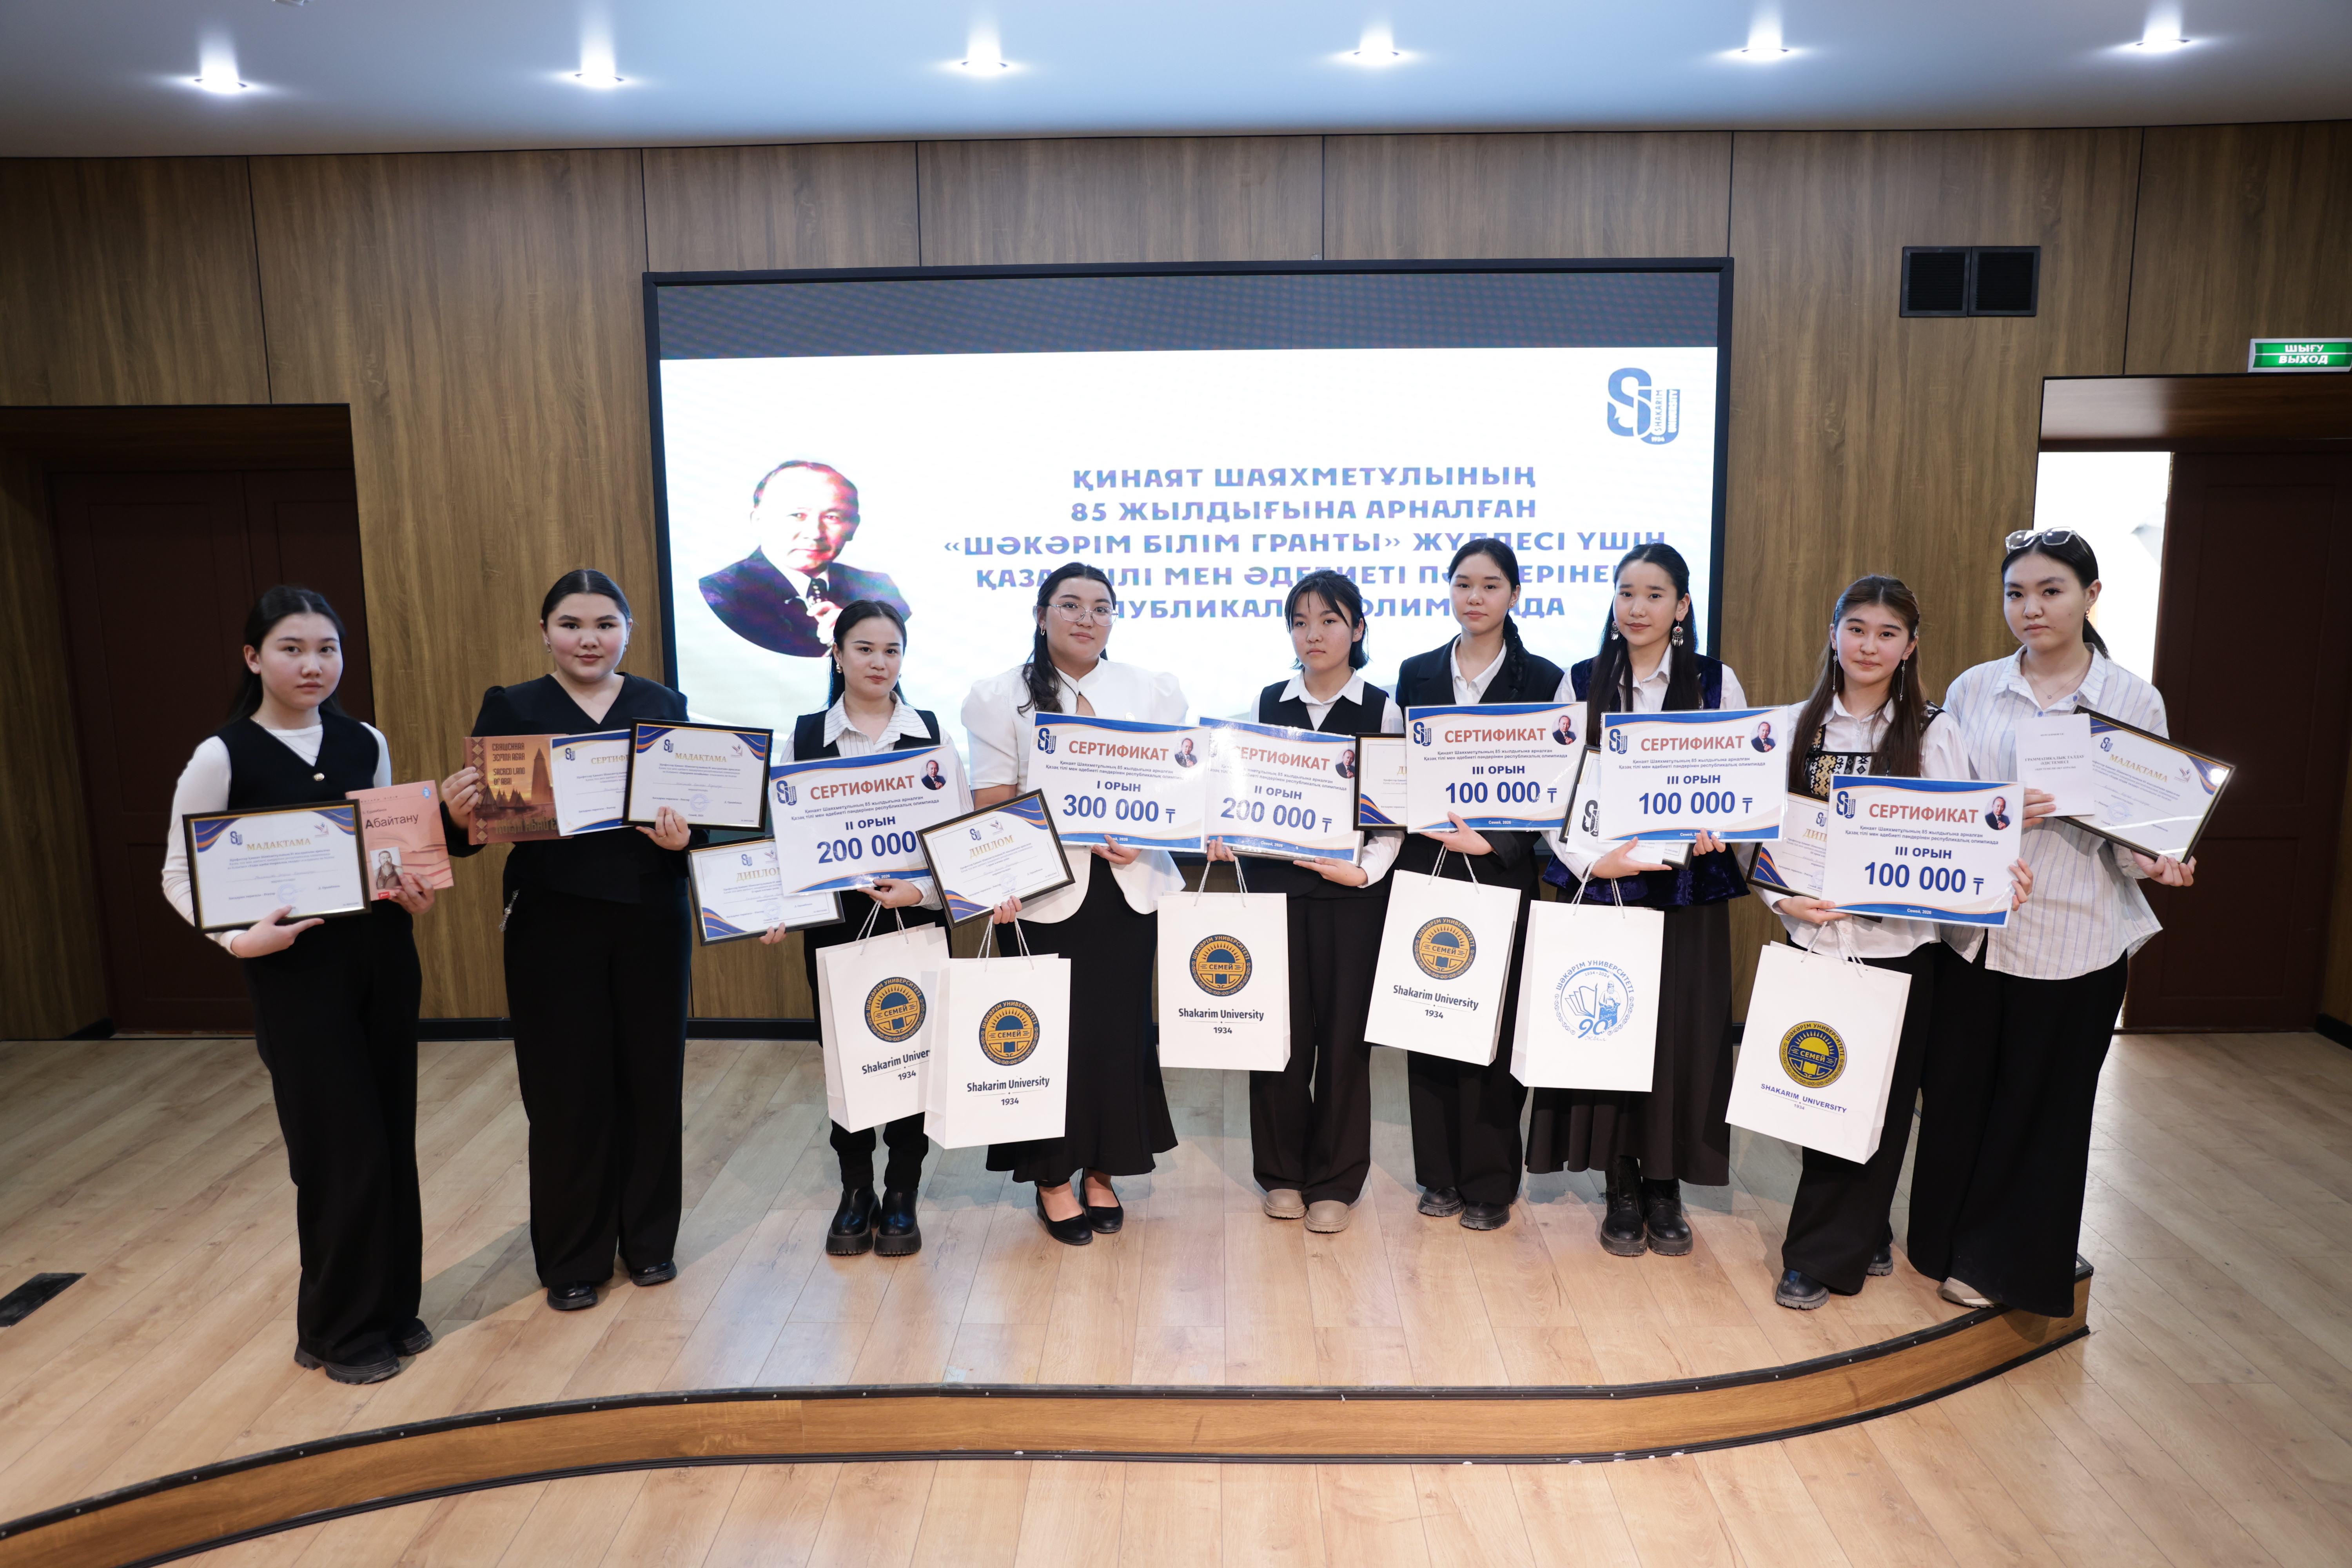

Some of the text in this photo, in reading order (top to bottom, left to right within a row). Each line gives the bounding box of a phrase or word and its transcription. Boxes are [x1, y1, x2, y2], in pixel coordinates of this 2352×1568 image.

[2279, 355, 2328, 365] ВЫХОД
[1074, 467, 1535, 491] ҚИНАЯТ ШАЯХМЕТҰЛЫНЫҢ
[1071, 500, 1535, 523] 85 ЖЫЛДЫҒЫНА АРНАЛҒАН
[944, 535, 1131, 555] «ШӘКӘРІМ
[1144, 534, 1239, 554] БІЛІМ
[1252, 534, 1400, 552] ГРАНТЫ»
[1165, 568, 1232, 586] МЕН
[1445, 728, 1546, 743] СЕРТИФИКАТ
[1641, 735, 1744, 751] СЕРТИФИКАТ
[492, 743, 524, 751] СВЯЩЕННАЯ
[1069, 740, 1169, 760] СЕРТИФИКАТ
[591, 755, 628, 764] СЕРТИФ
[675, 753, 727, 762] МАДАҚТАМА
[1232, 745, 1330, 770] ЕРТИФИКАТ
[1488, 765, 1524, 774] ОРЫН
[2109, 754, 2168, 782] МАДАҚТАМА
[810, 775, 914, 800] СЕРТИФИКАТ
[1104, 781, 1140, 792] ОРЫН
[1683, 775, 1720, 784] ОРЫН
[1266, 787, 1302, 800] ОРЫН
[1445, 782, 1488, 803] 100
[1497, 781, 1540, 803] 000
[822, 803, 864, 811] Шаяхметұлының
[875, 802, 912, 811] республикалық
[1062, 794, 1106, 818] 300
[1115, 799, 1159, 822] 000
[1639, 792, 1681, 815] 100
[1690, 791, 1735, 814] 000
[365, 814, 418, 829] Абайтану
[858, 816, 895, 828] ОРЫН
[1220, 797, 1265, 822] 200
[1273, 804, 1316, 830] 000
[1869, 803, 1978, 823] СЕРТИФИКАТ
[247, 838, 311, 851] МАДАҚТАМА
[817, 831, 916, 864] 200 000
[969, 835, 1014, 859] ДИПЛОМ
[1912, 848, 1951, 859] ОРЫН
[1865, 862, 1909, 887] 100
[1919, 866, 1965, 893] 000
[1417, 918, 1475, 947] ШӘКӘРІМ УНИВЕРСИТЕТІ
[1192, 936, 1250, 960] ШӘКӘРІМ УНИВЕРСИТЕТІ
[1432, 946, 1456, 955] СЕМЕЙ
[1556, 960, 1634, 993] ШӘКӘРІМ УНИВЕРСИТЕТІ
[866, 978, 922, 1010] ШӘКӘРІМ УНИВЕРСИТЕТІ
[1394, 985, 1479, 1011] Shakarim University
[884, 1005, 908, 1016] СЕМЕЙ
[982, 1002, 1037, 1029] ШӘКӘРІМ УНИВЕРСИТЕТІ
[1179, 1008, 1264, 1021] Shakarim University
[1425, 1009, 1443, 1018] 1934
[1578, 1019, 1608, 1038] 90
[1786, 1023, 1844, 1056] ШӘКӘРІМ УНИВЕРСИТЕТІ
[862, 1050, 930, 1074] Shakarim Univer
[1800, 1051, 1825, 1062] СЕМЕЙ
[898, 1071, 916, 1080] 1934
[967, 1076, 1049, 1092] Shakarim University
[1761, 1083, 1847, 1113] SHAKARIM UNIVERSITY
